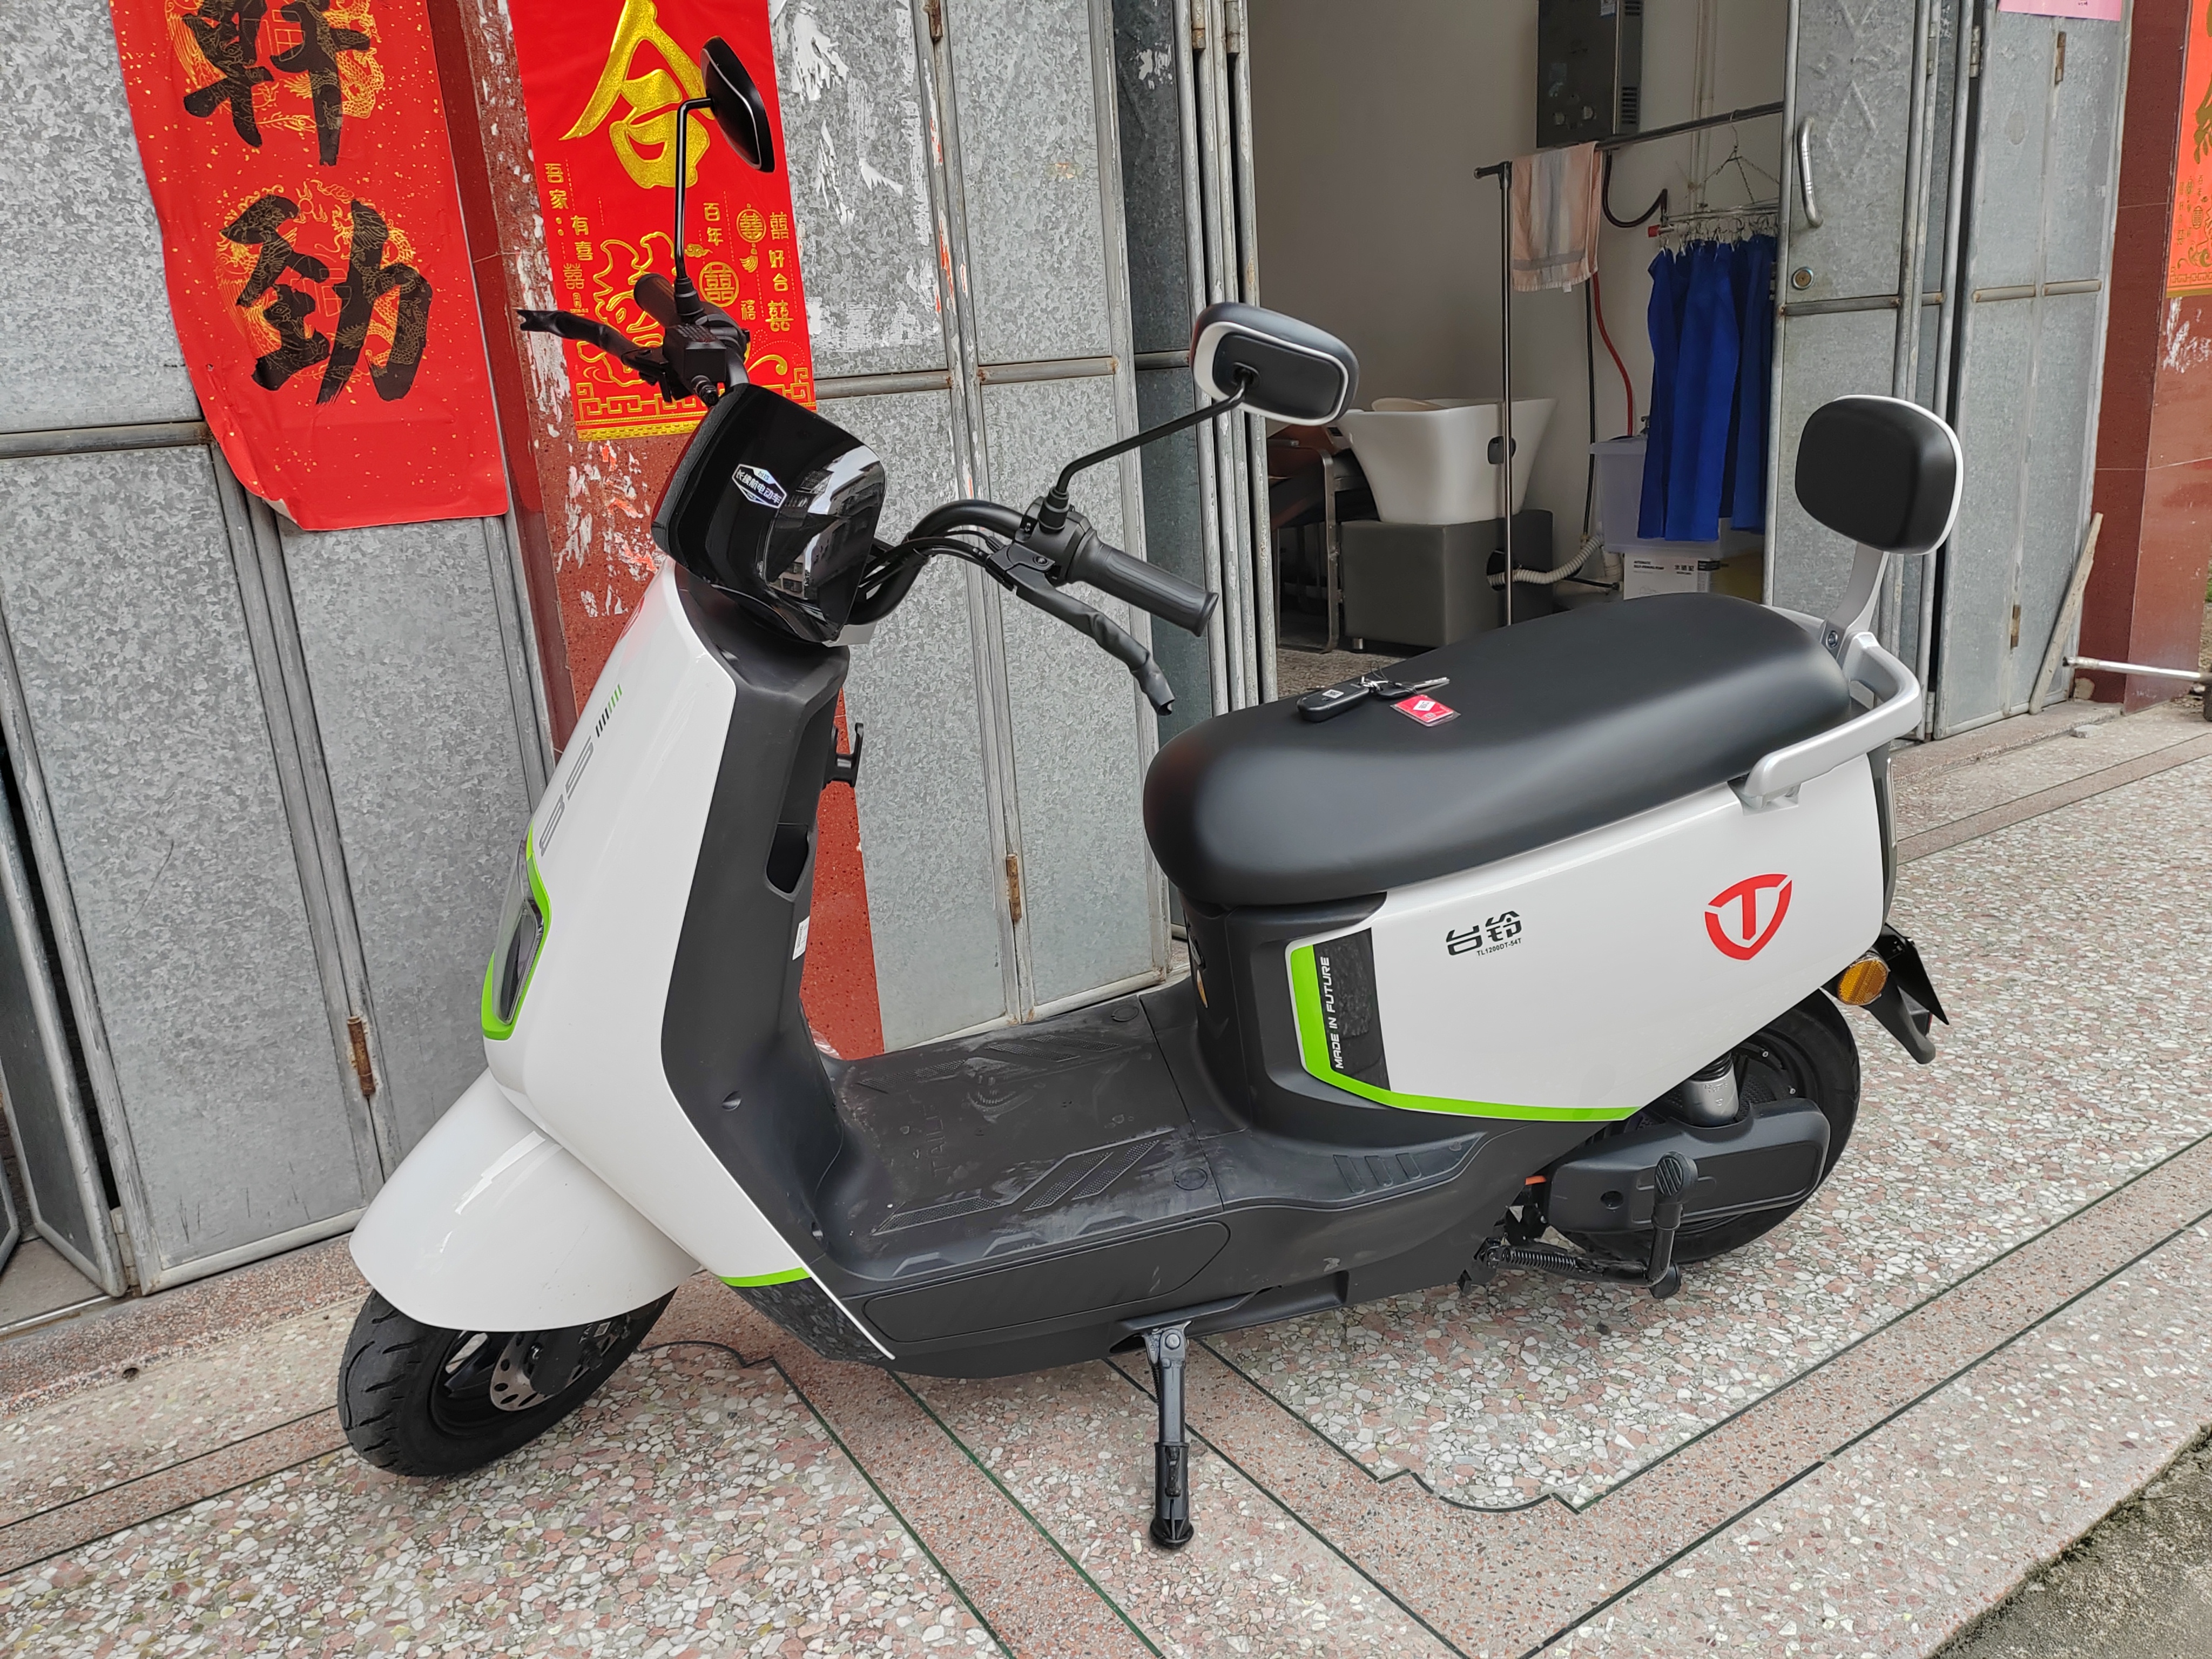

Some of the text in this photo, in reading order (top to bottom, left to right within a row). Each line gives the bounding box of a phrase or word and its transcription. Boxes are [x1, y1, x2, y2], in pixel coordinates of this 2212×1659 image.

[559, 0, 716, 188] 合
[570, 215, 594, 261] 有喜
[703, 203, 724, 246] 百年
[736, 469, 782, 504] 长续航电动车
[1446, 911, 1522, 956] 台铃
[1476, 938, 1522, 956] TL1200DT-54T
[1320, 956, 1344, 1069] MADE IN FUTURE
